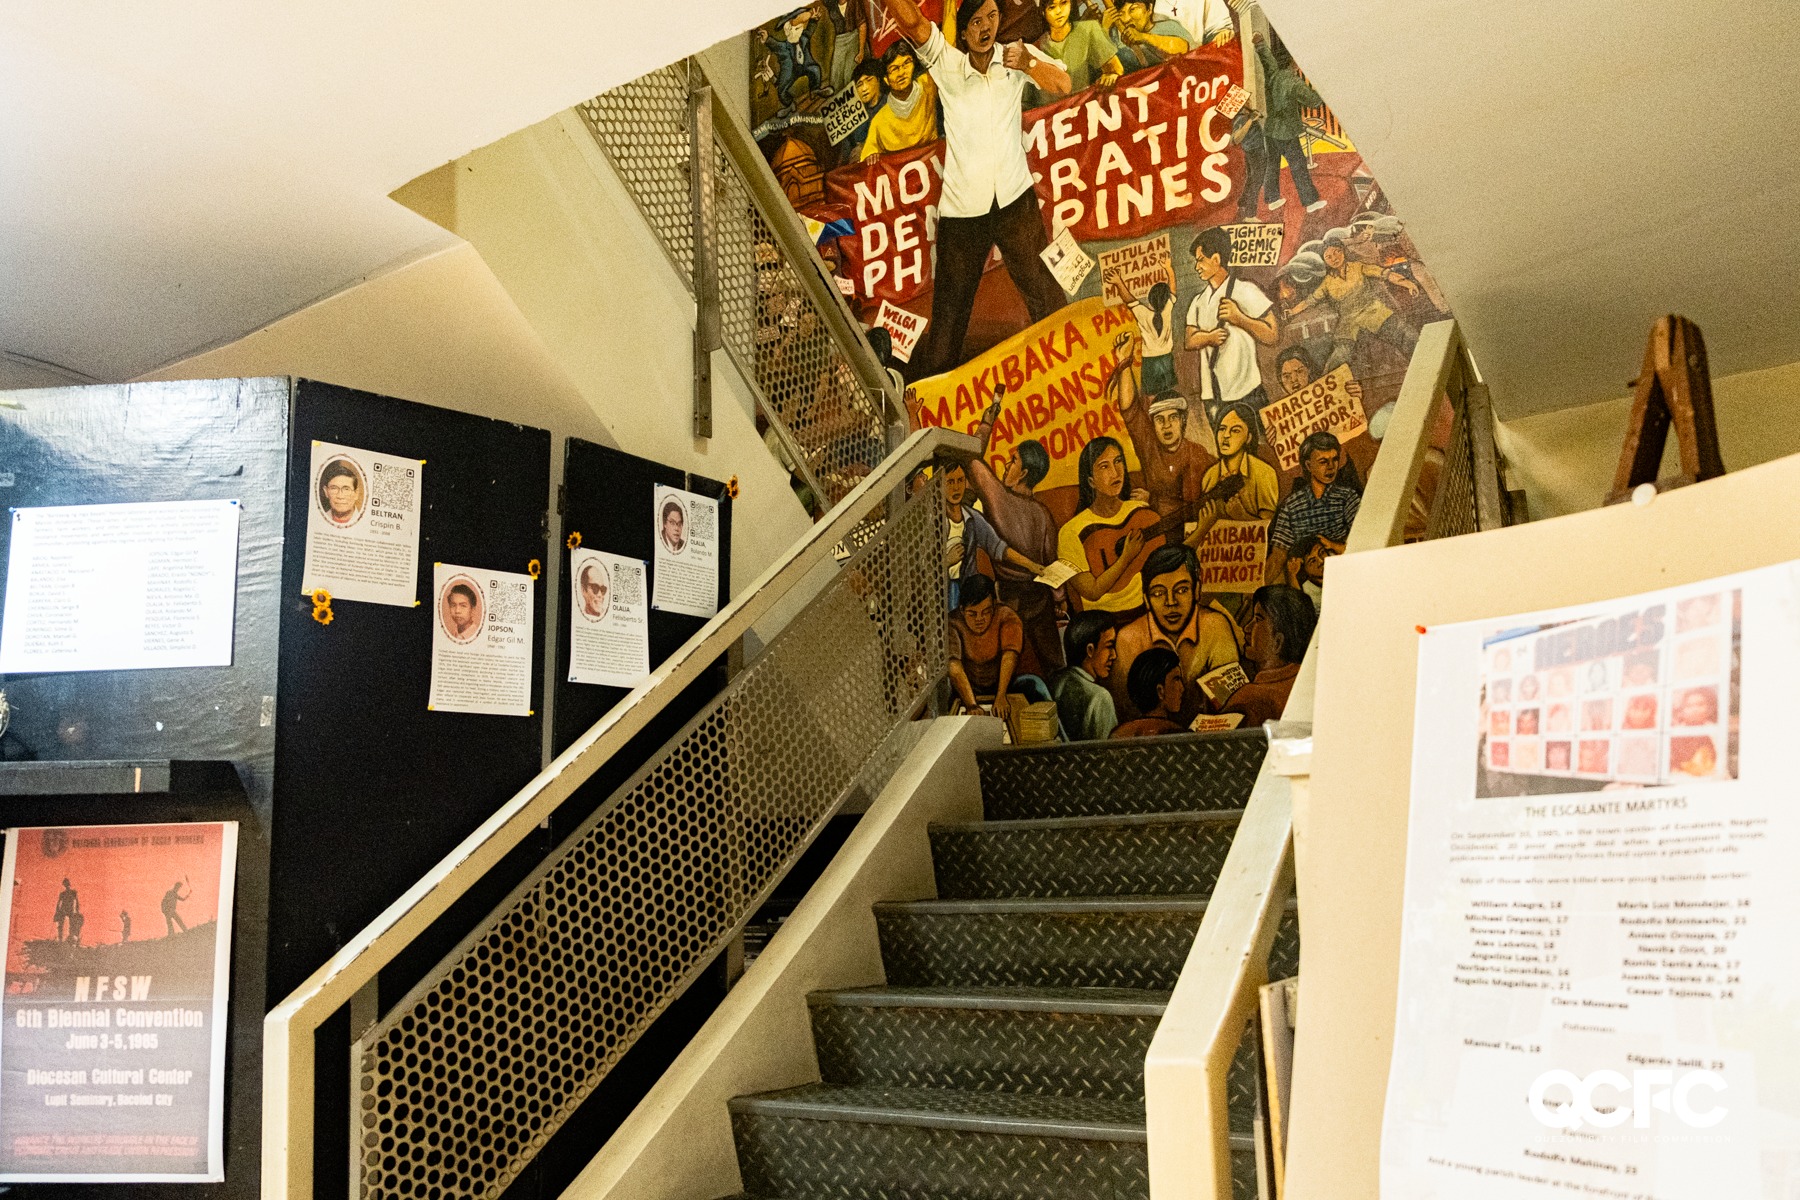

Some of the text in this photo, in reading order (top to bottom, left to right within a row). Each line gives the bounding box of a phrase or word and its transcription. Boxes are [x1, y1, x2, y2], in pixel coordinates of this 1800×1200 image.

[821, 86, 855, 118] DOWN
[1178, 75, 1229, 109] for
[826, 100, 862, 132] CLERICO
[829, 104, 849, 120] WITH
[829, 111, 867, 142] FASCISM
[1032, 105, 1231, 202] RATIC
[1038, 152, 1232, 241] PINES
[1227, 225, 1267, 240] FIGHT
[1101, 236, 1166, 267] TUTULAN
[883, 305, 918, 333] WELGA
[883, 321, 914, 349] KAMI!
[920, 320, 1089, 428] MAKIBAKA
[1265, 374, 1338, 423] MARCOS
[370, 519, 395, 530] Crispin
[371, 509, 405, 521] BELTRAN,
[1200, 545, 1256, 564] HUWAG
[612, 604, 632, 613] OLALIA,
[612, 614, 637, 624] Felixberto
[487, 624, 515, 634] JOPSON,
[487, 634, 506, 644] Edgar
[1525, 797, 1688, 818] THE ESCALANTE MARTYRS
[74, 975, 153, 1002] NFSW
[16, 1007, 204, 1028] 6th Biennial Convention
[66, 1033, 98, 1050] June
[27, 1068, 193, 1085] Diocesan Cultural Center
[155, 1094, 173, 1107] City
